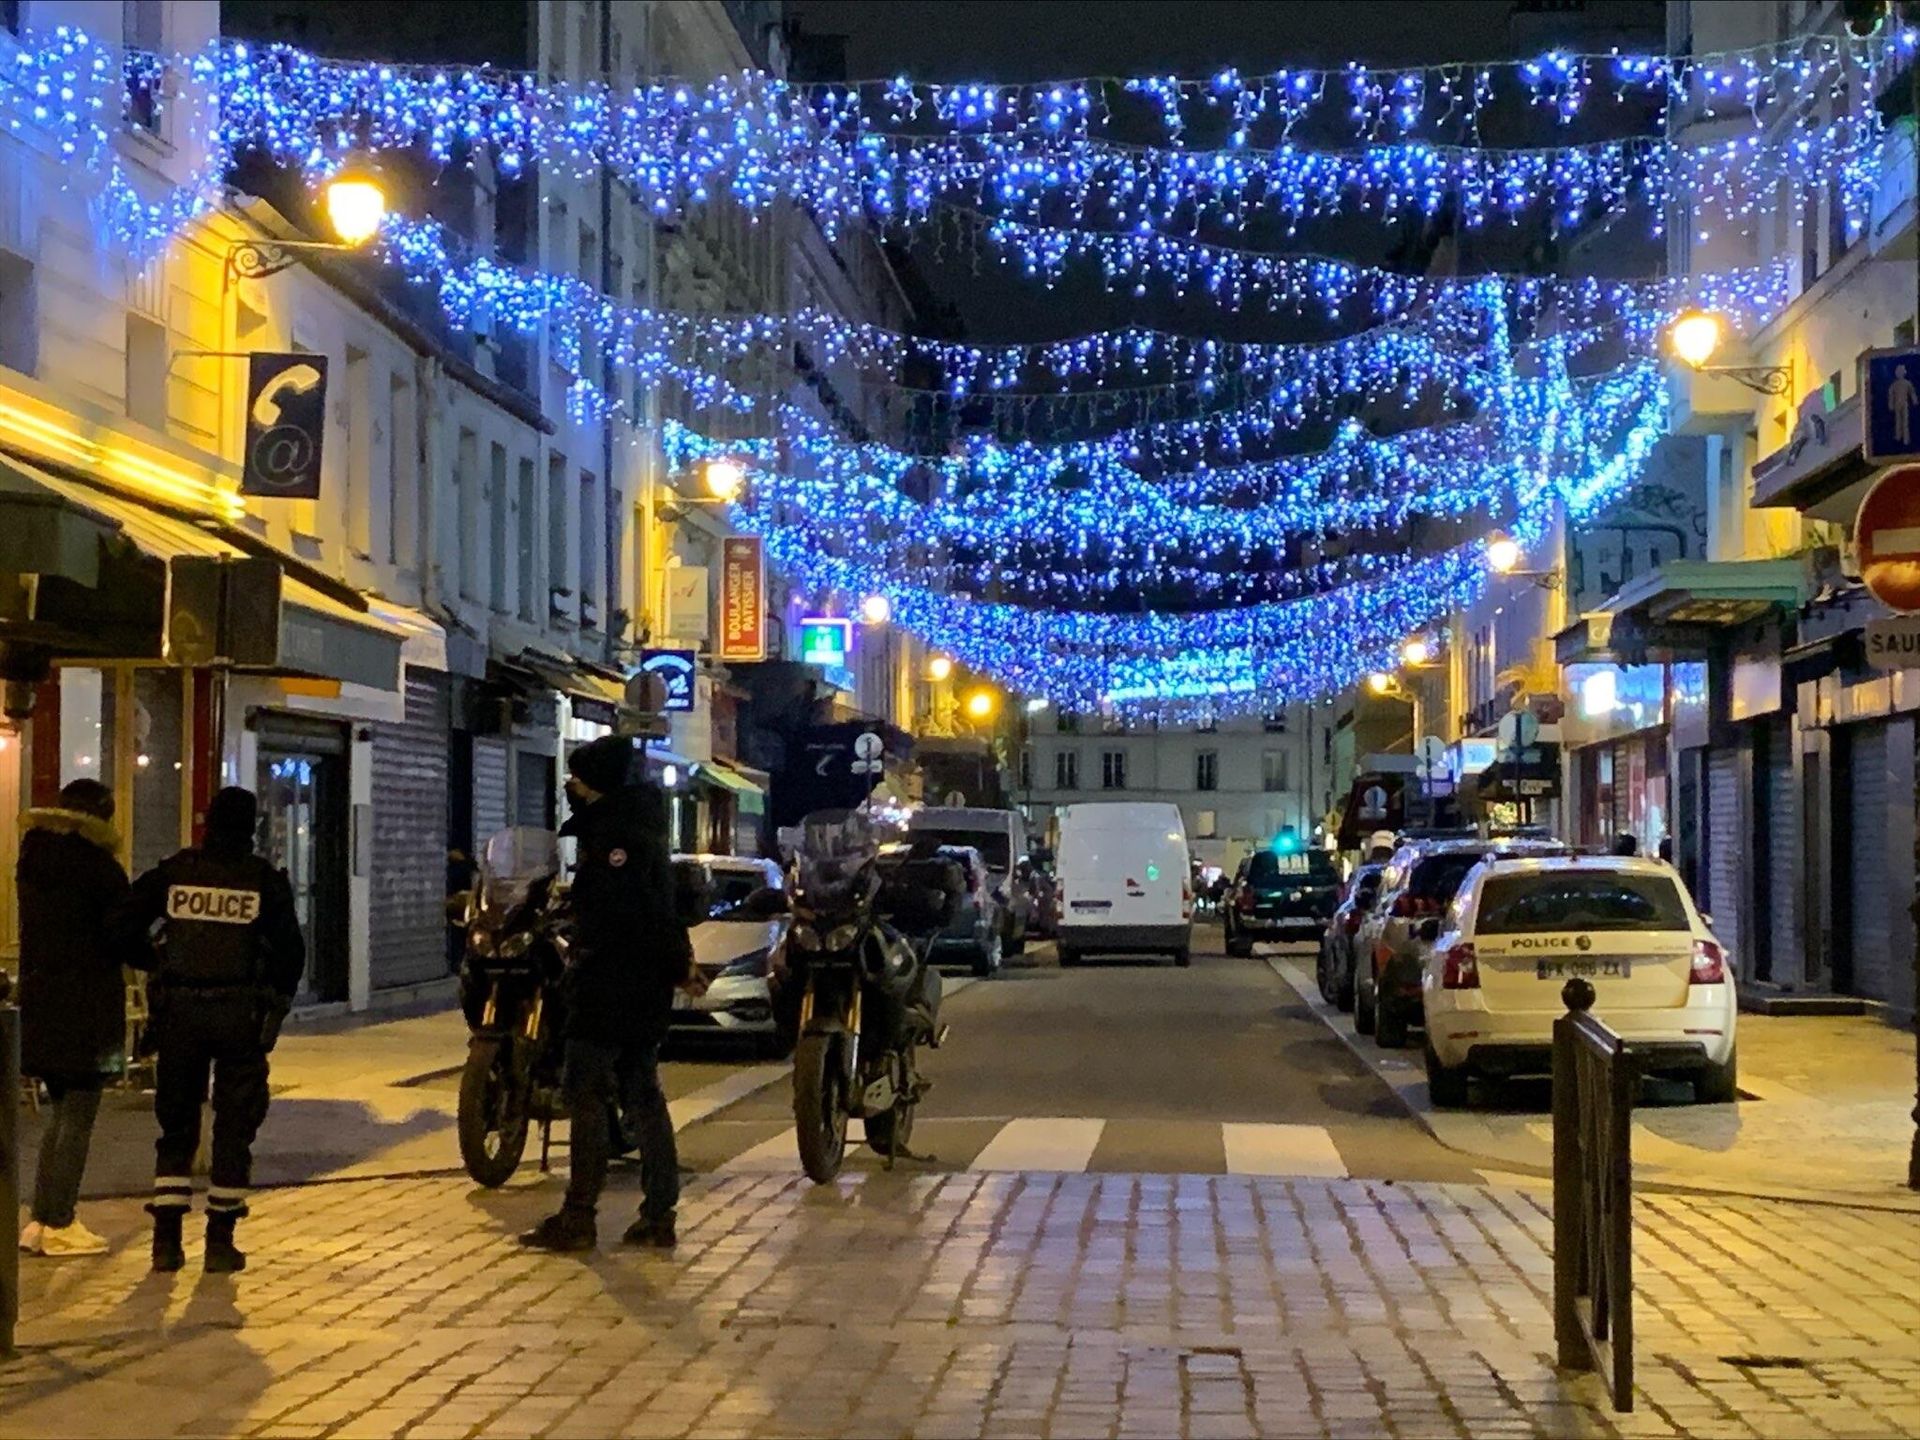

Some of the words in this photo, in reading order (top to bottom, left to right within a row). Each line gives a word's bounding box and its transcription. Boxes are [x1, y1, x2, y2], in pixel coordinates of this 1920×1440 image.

[729, 562, 741, 640] BOULANGER
[1871, 633, 1920, 654] SAU
[172, 890, 255, 919] POLICE
[1512, 937, 1570, 948] POLICE
